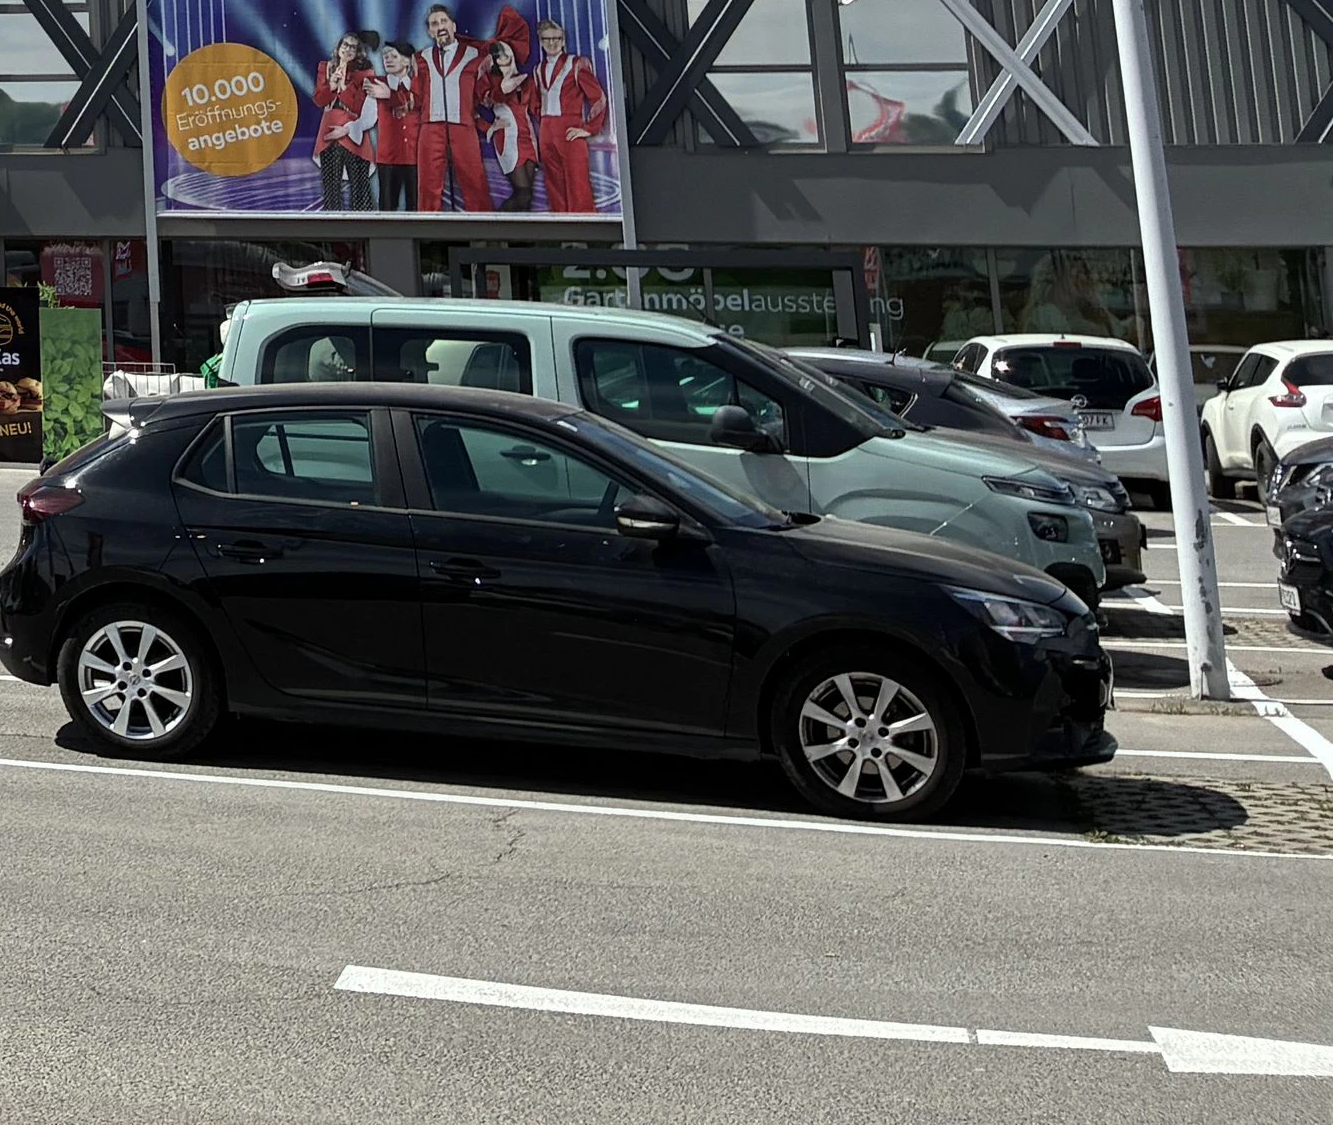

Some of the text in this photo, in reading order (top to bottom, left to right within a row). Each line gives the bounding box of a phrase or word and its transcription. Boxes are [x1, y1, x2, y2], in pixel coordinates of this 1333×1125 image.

[181, 71, 265, 107] 10.000
[176, 99, 282, 131] Eröffnungs-
[188, 119, 284, 150] angebote
